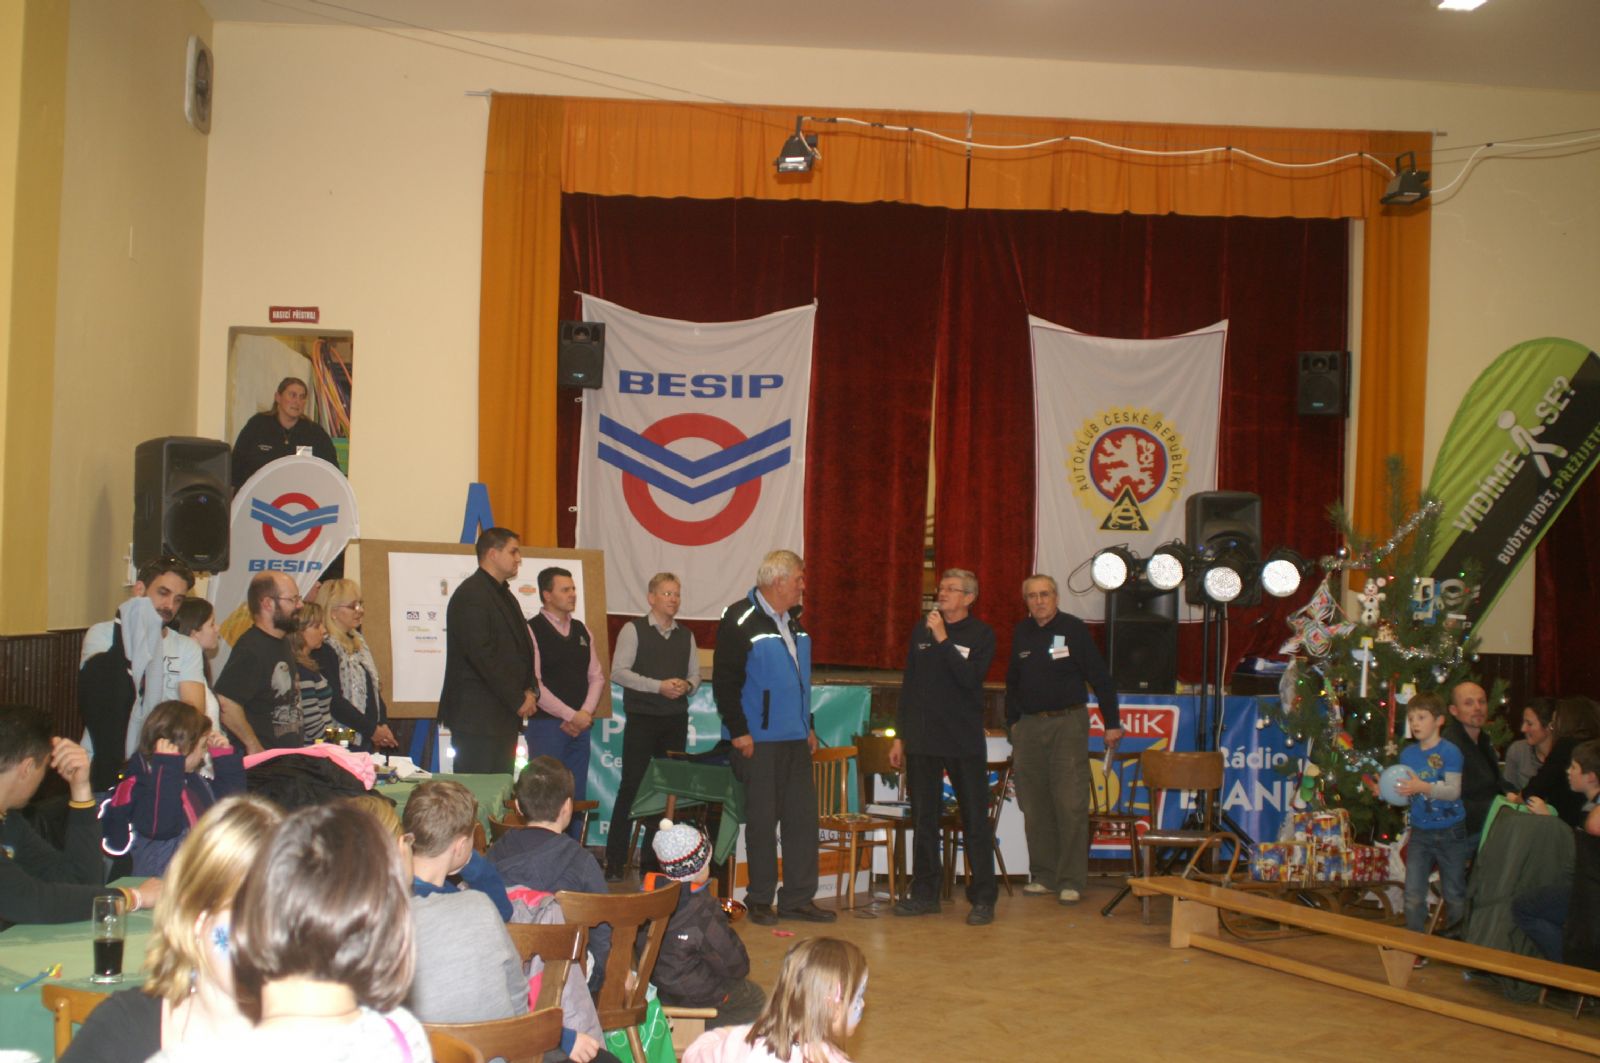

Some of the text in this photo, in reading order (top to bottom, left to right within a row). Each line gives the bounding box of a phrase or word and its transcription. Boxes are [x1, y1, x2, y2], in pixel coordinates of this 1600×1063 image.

[618, 369, 784, 399] BESIP
[1073, 422, 1100, 492] AUTOKLUB
[1152, 420, 1183, 495] REPUBLIKY
[1453, 375, 1577, 533] VIDÍME SE?
[247, 558, 323, 573] BESIP
[1219, 745, 1289, 770] Rádio
